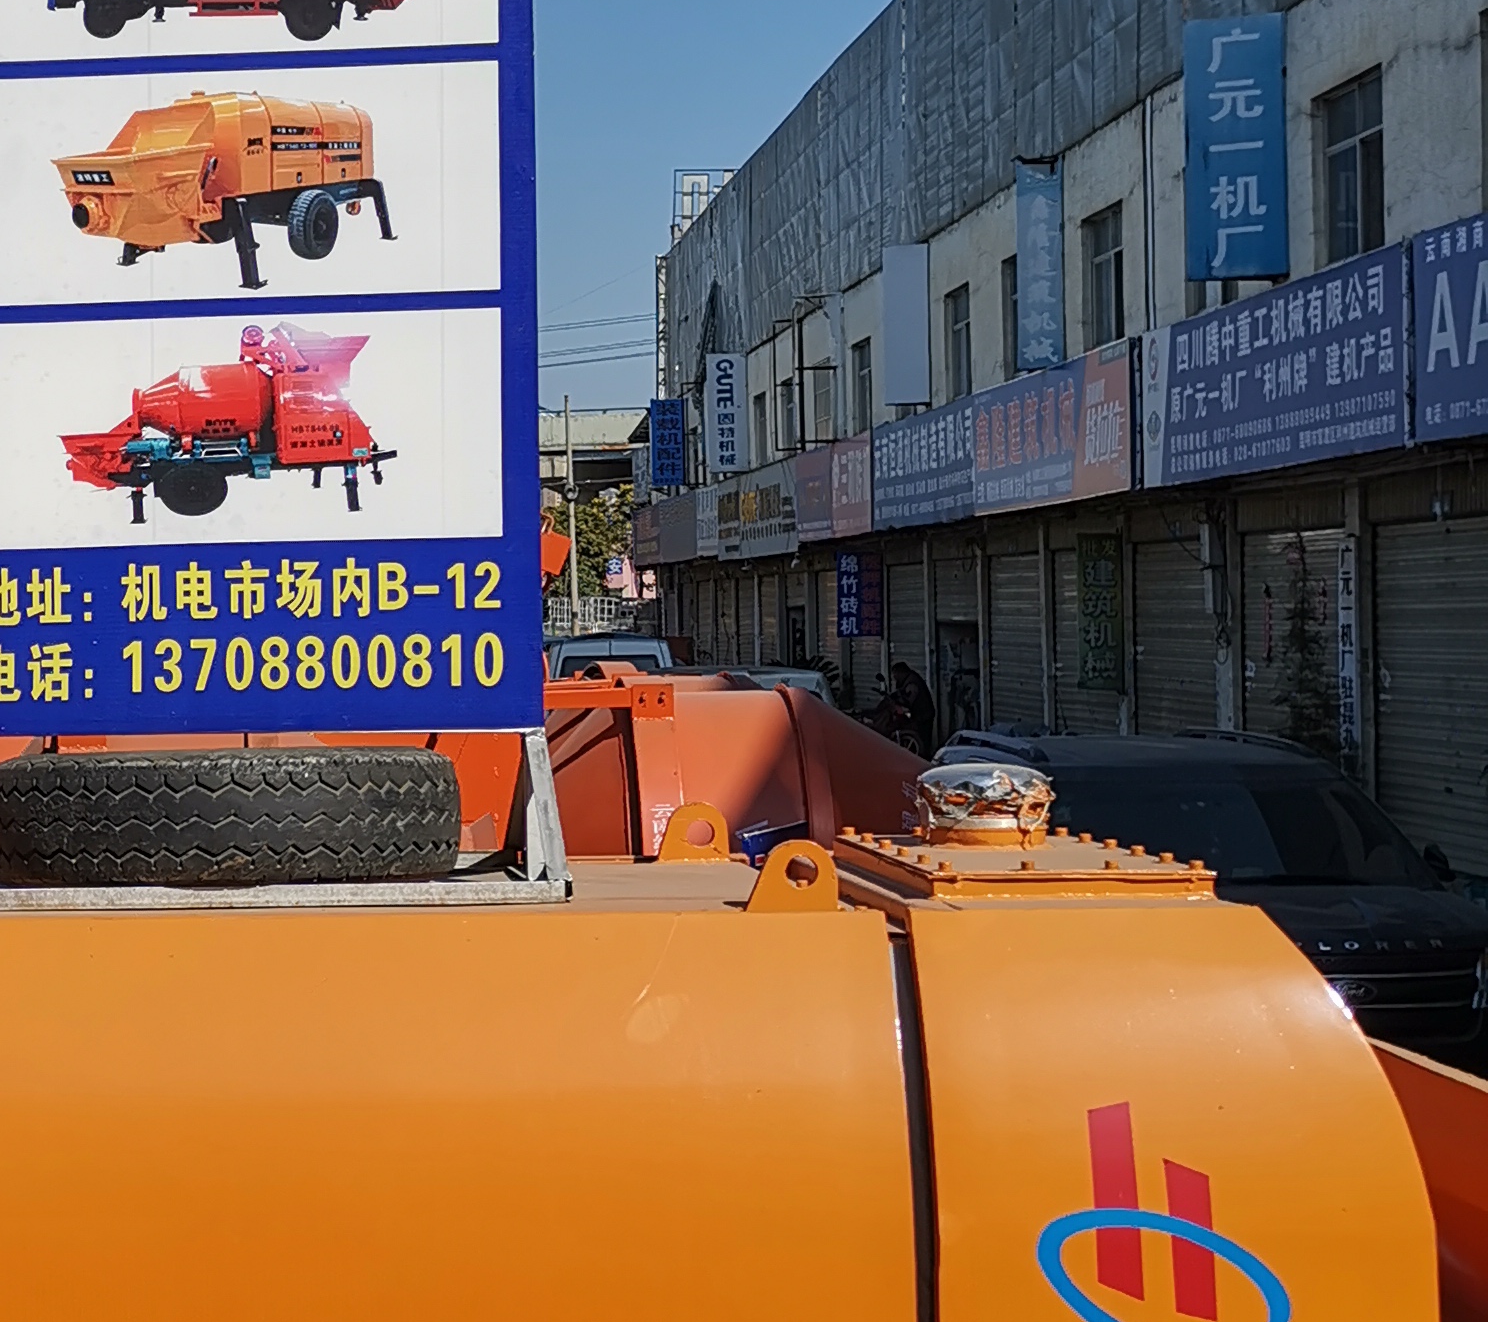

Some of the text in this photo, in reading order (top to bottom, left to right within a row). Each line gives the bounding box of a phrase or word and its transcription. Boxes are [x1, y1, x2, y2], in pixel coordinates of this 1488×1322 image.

[1207, 28, 1268, 268] 广元一机厂
[1176, 264, 1384, 374] 四川腾中重工机械有限公司
[655, 401, 681, 476] 装载机配件
[121, 558, 502, 624] 机电市场内B-12
[840, 554, 859, 635] 绵竹砖机
[1083, 559, 1118, 679] 建筑机械
[122, 632, 503, 693] 13708800810
